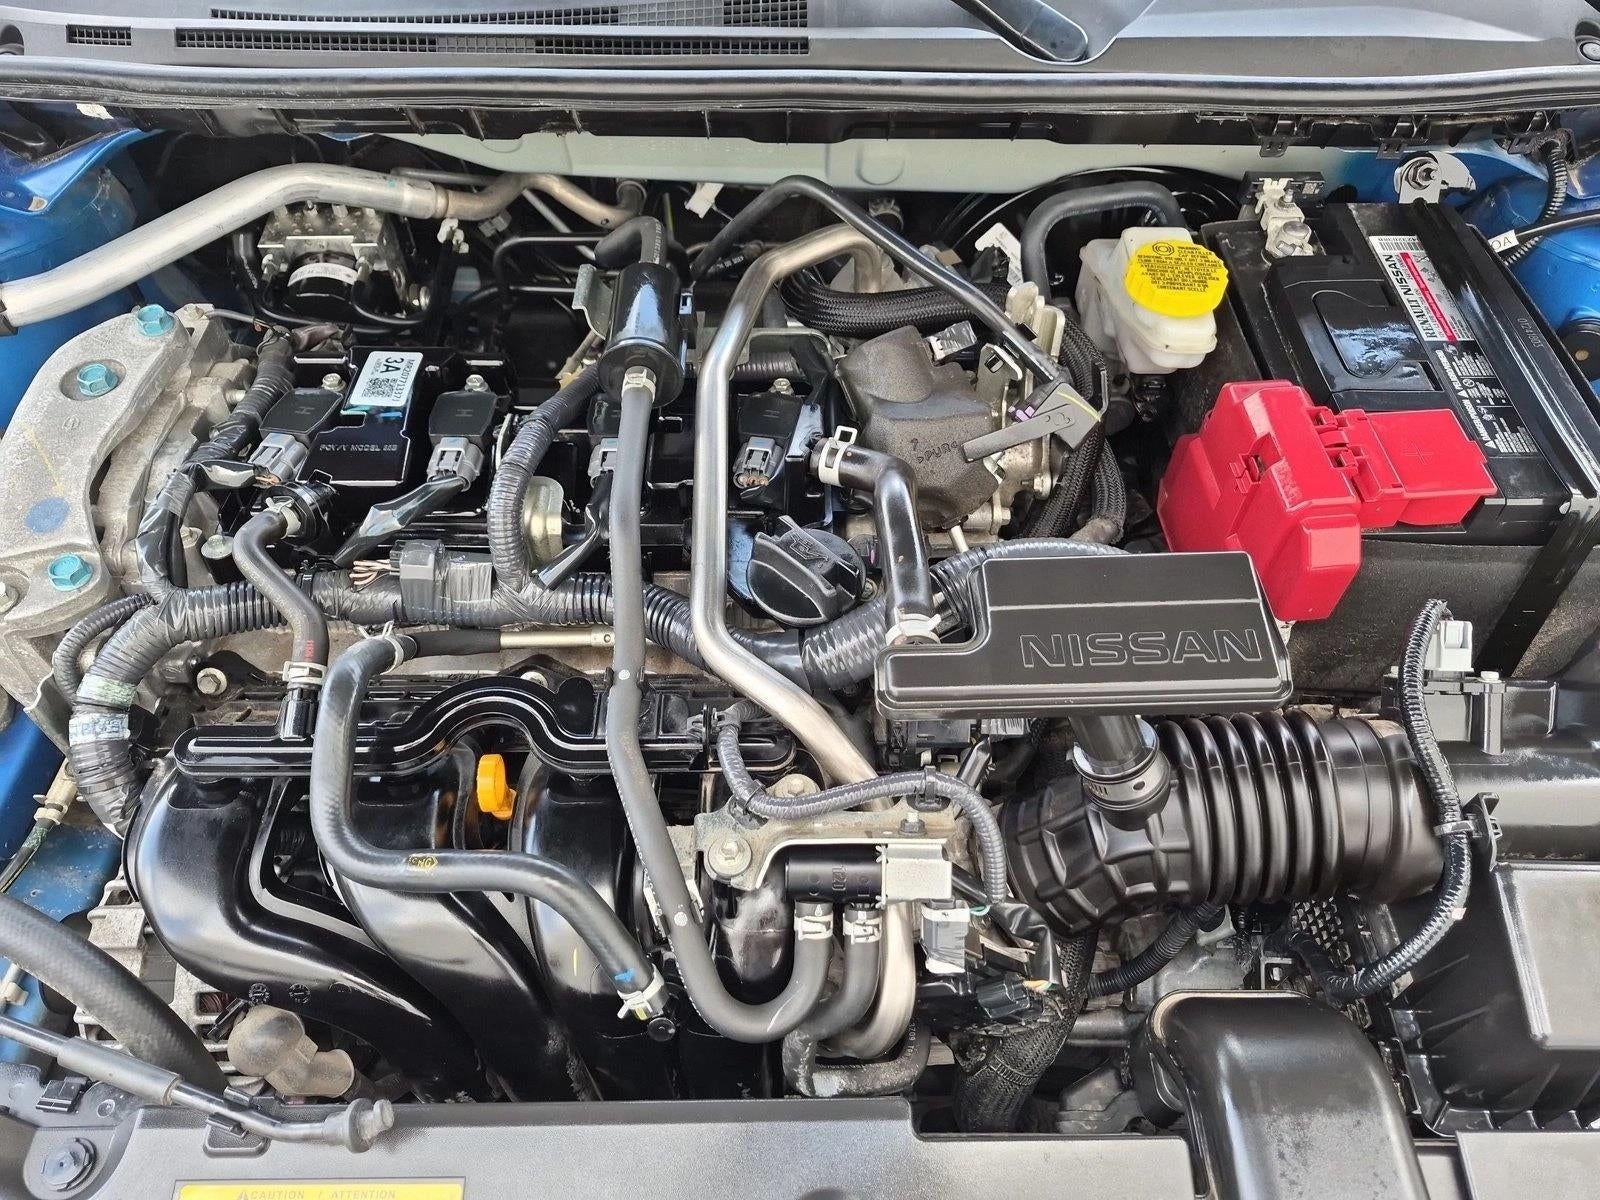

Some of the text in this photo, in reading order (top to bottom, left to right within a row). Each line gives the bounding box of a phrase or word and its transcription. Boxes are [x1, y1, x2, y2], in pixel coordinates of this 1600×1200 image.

[1383, 254, 1413, 296] NISSAN
[1407, 298, 1438, 339] RENAULT
[380, 356, 405, 374] 3A
[1020, 629, 1262, 668] NISSAN
[250, 1190, 305, 1200] CAUTION
[331, 1190, 396, 1200] ATTENTION
